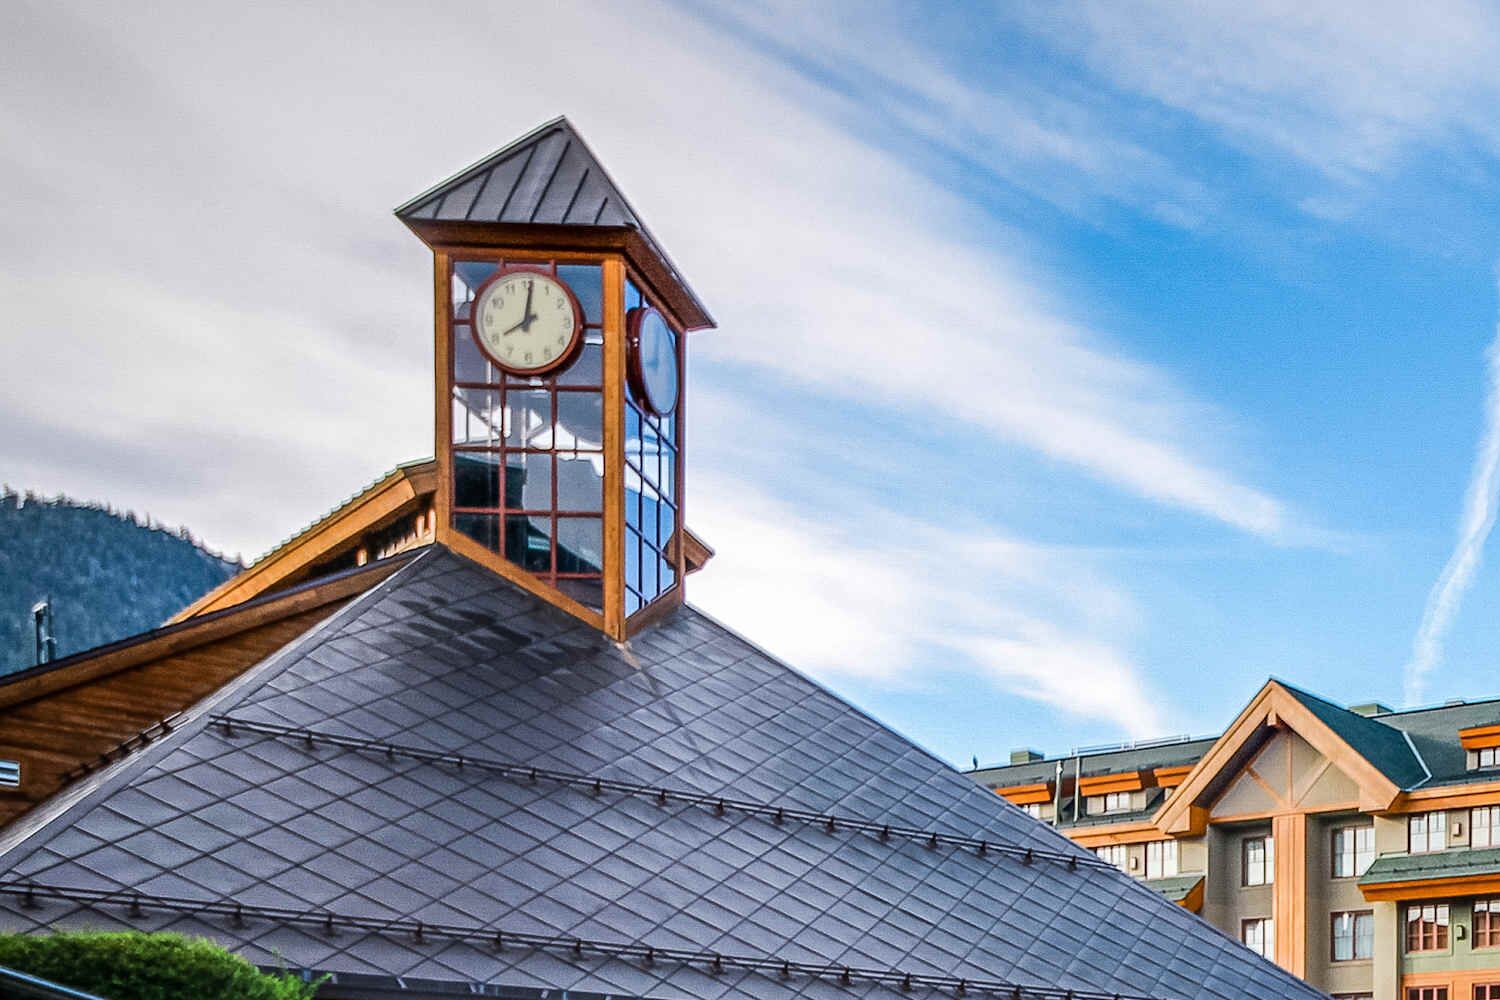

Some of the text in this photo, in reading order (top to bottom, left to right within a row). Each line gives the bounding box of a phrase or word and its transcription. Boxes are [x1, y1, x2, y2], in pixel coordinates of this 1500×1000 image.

[505, 284, 515, 294] 11
[544, 285, 550, 295] 1
[492, 297, 505, 310] 10
[556, 297, 565, 309] 2
[485, 314, 494, 327] 9
[564, 314, 571, 327] 3
[492, 333, 500, 345] 8
[558, 335, 566, 346] 4
[506, 345, 514, 357] 7
[543, 346, 552, 360] 5
[524, 352, 533, 364] 6
